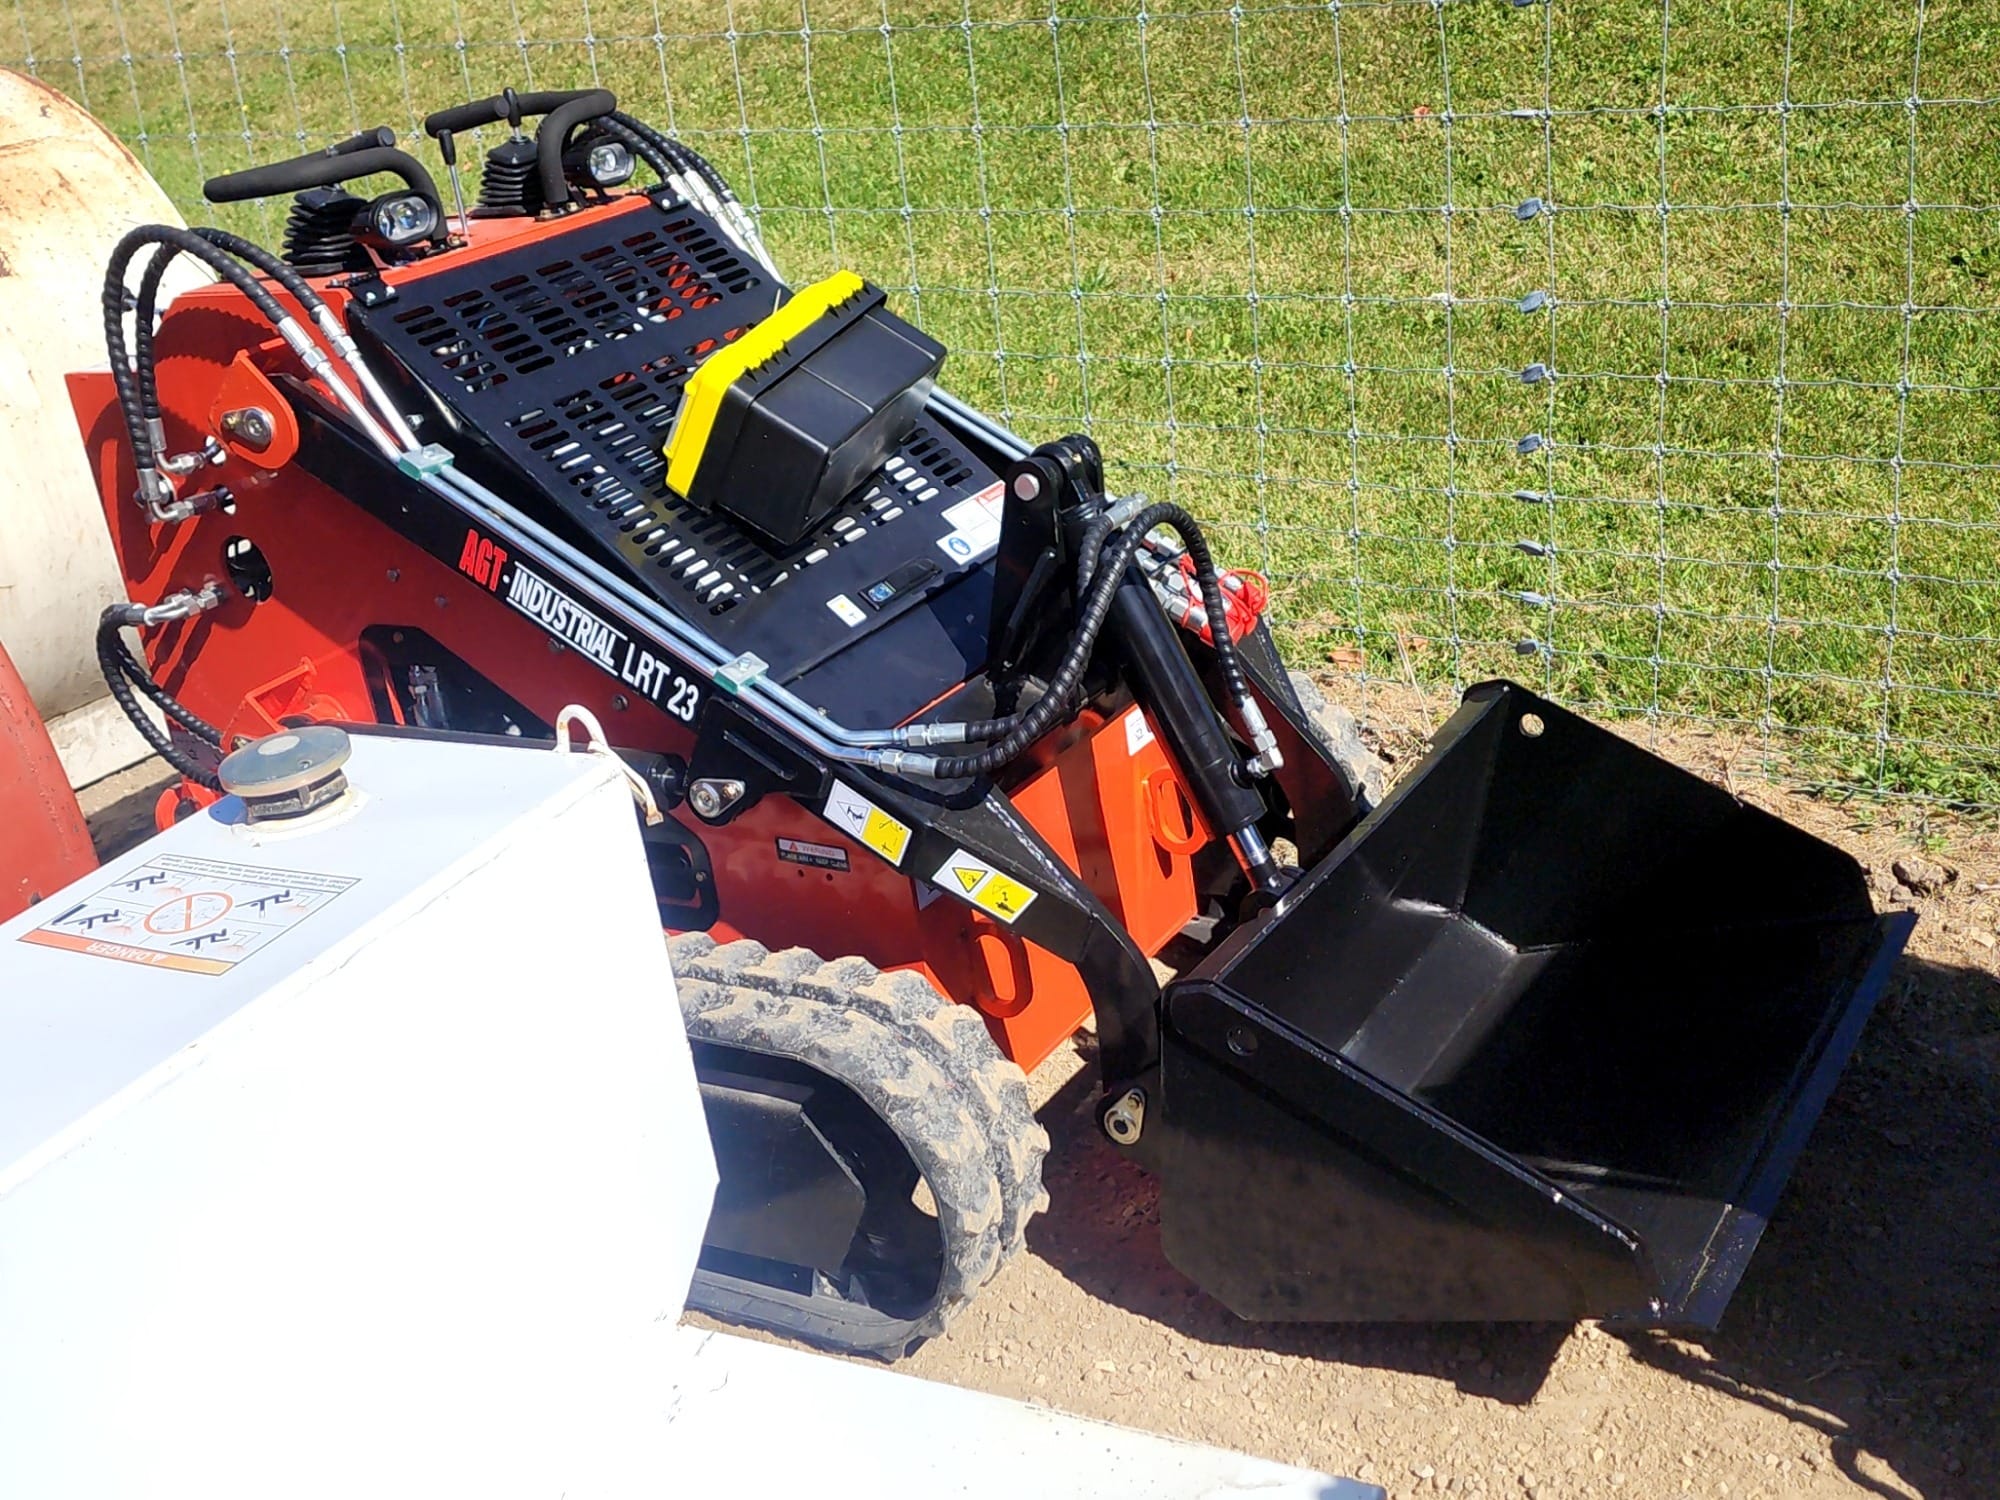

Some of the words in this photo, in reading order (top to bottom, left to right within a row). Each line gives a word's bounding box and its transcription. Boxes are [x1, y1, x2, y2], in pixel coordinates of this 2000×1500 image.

[458, 528, 508, 593] AGT
[509, 567, 618, 666] INDUSTRIAL
[621, 641, 671, 701] LRT
[666, 676, 700, 722] 23
[85, 942, 149, 961] DANGER
